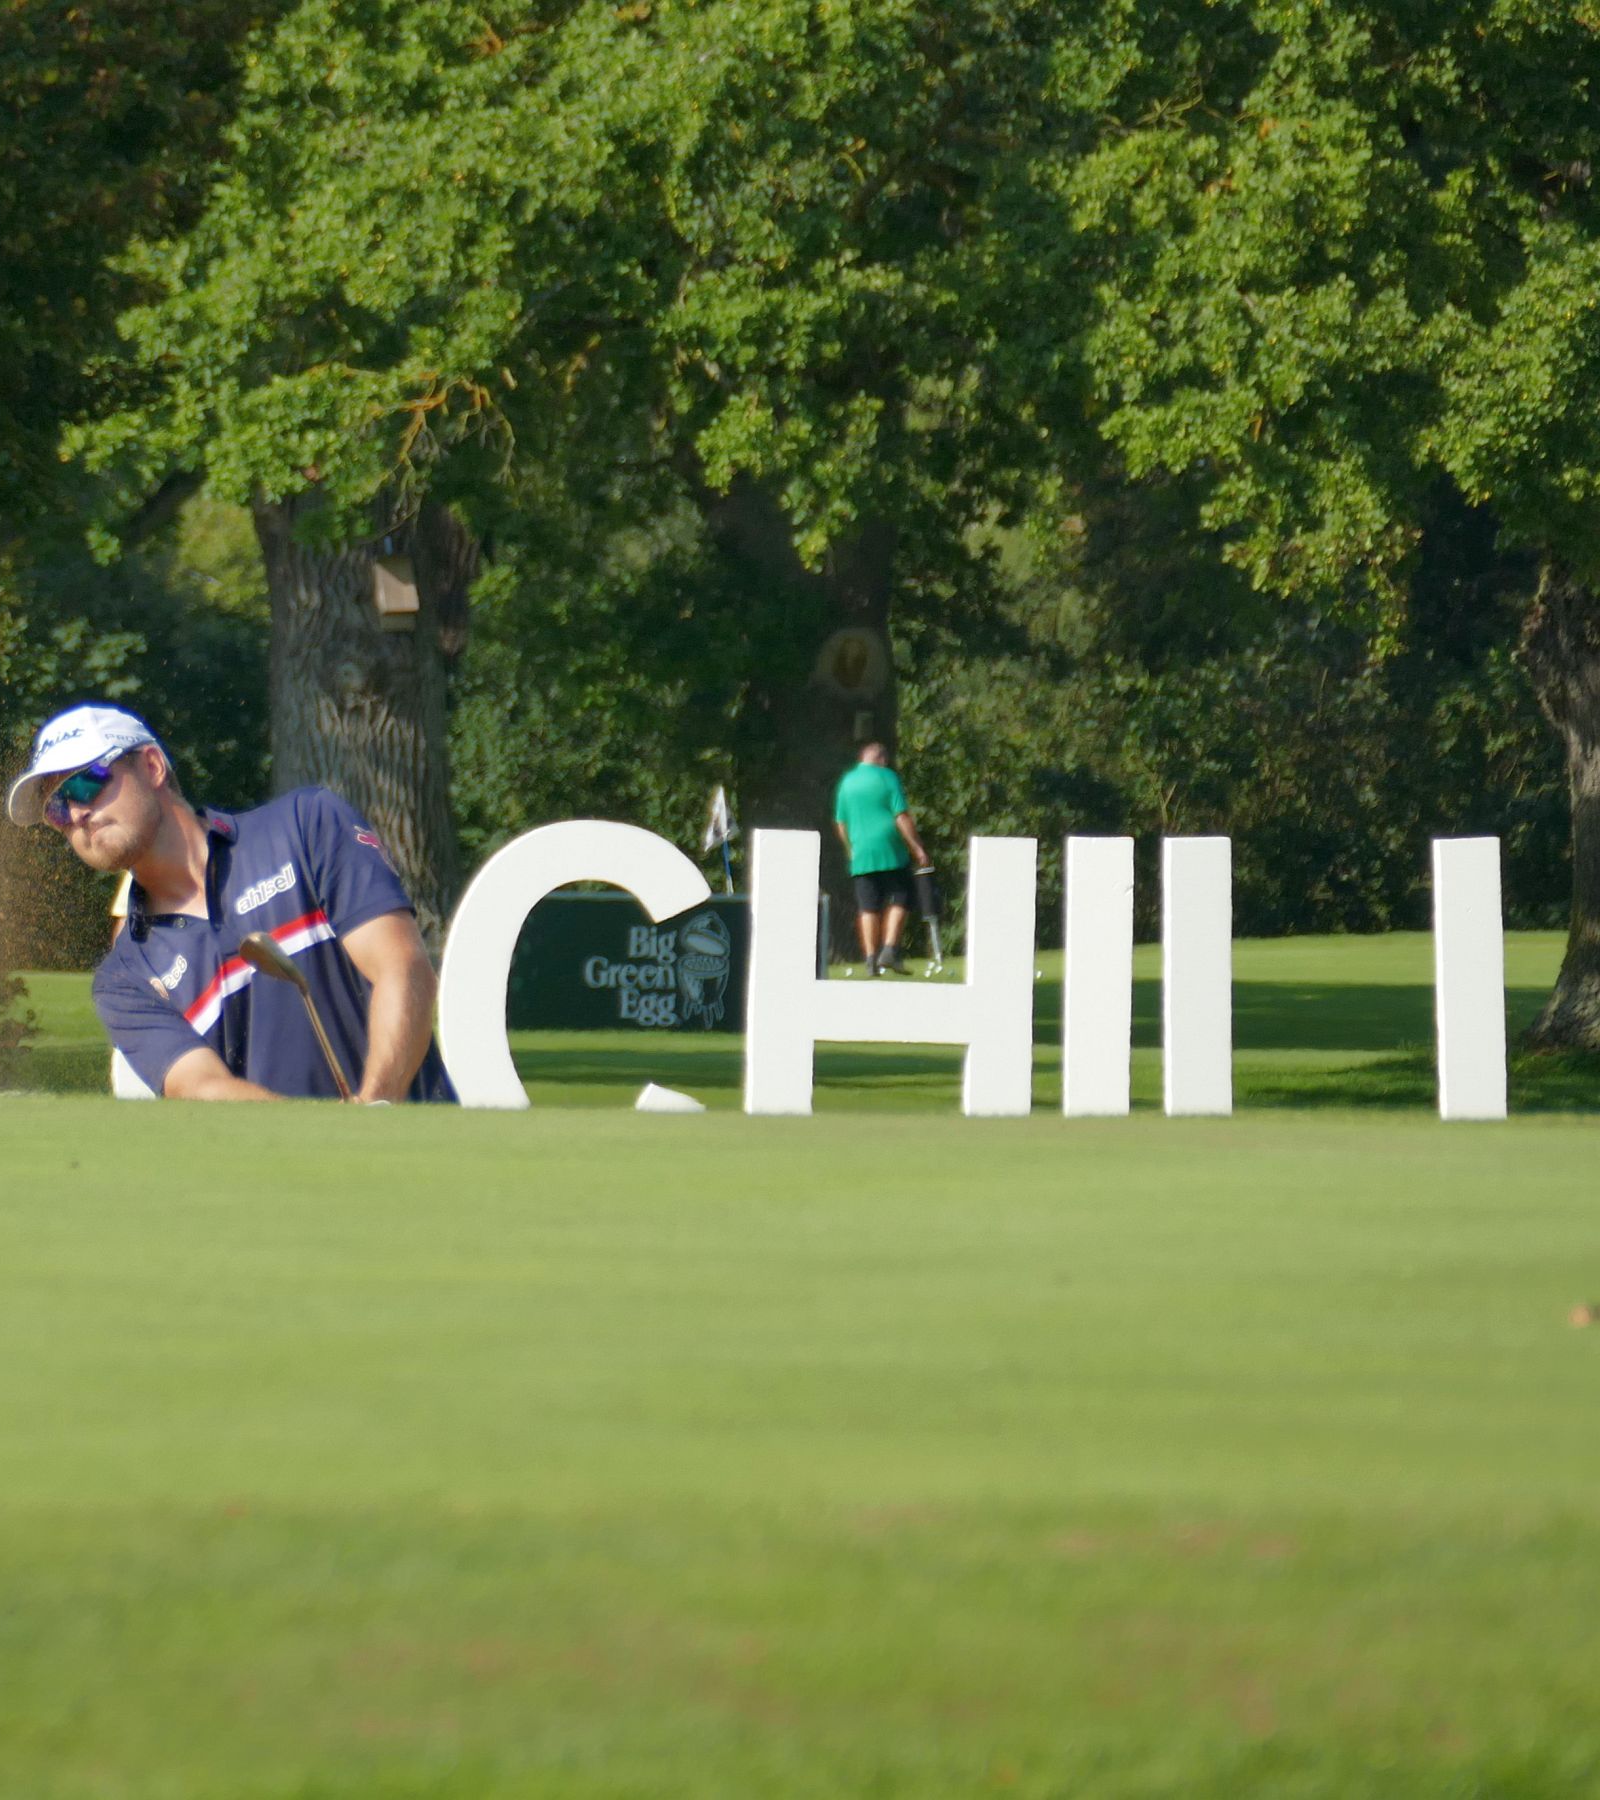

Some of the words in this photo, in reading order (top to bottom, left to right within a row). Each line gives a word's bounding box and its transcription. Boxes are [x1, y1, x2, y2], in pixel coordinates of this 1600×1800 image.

[235, 862, 297, 916] ahlsell
[629, 925, 677, 964] Big
[584, 955, 677, 989] Green
[619, 989, 678, 1027] Egg
